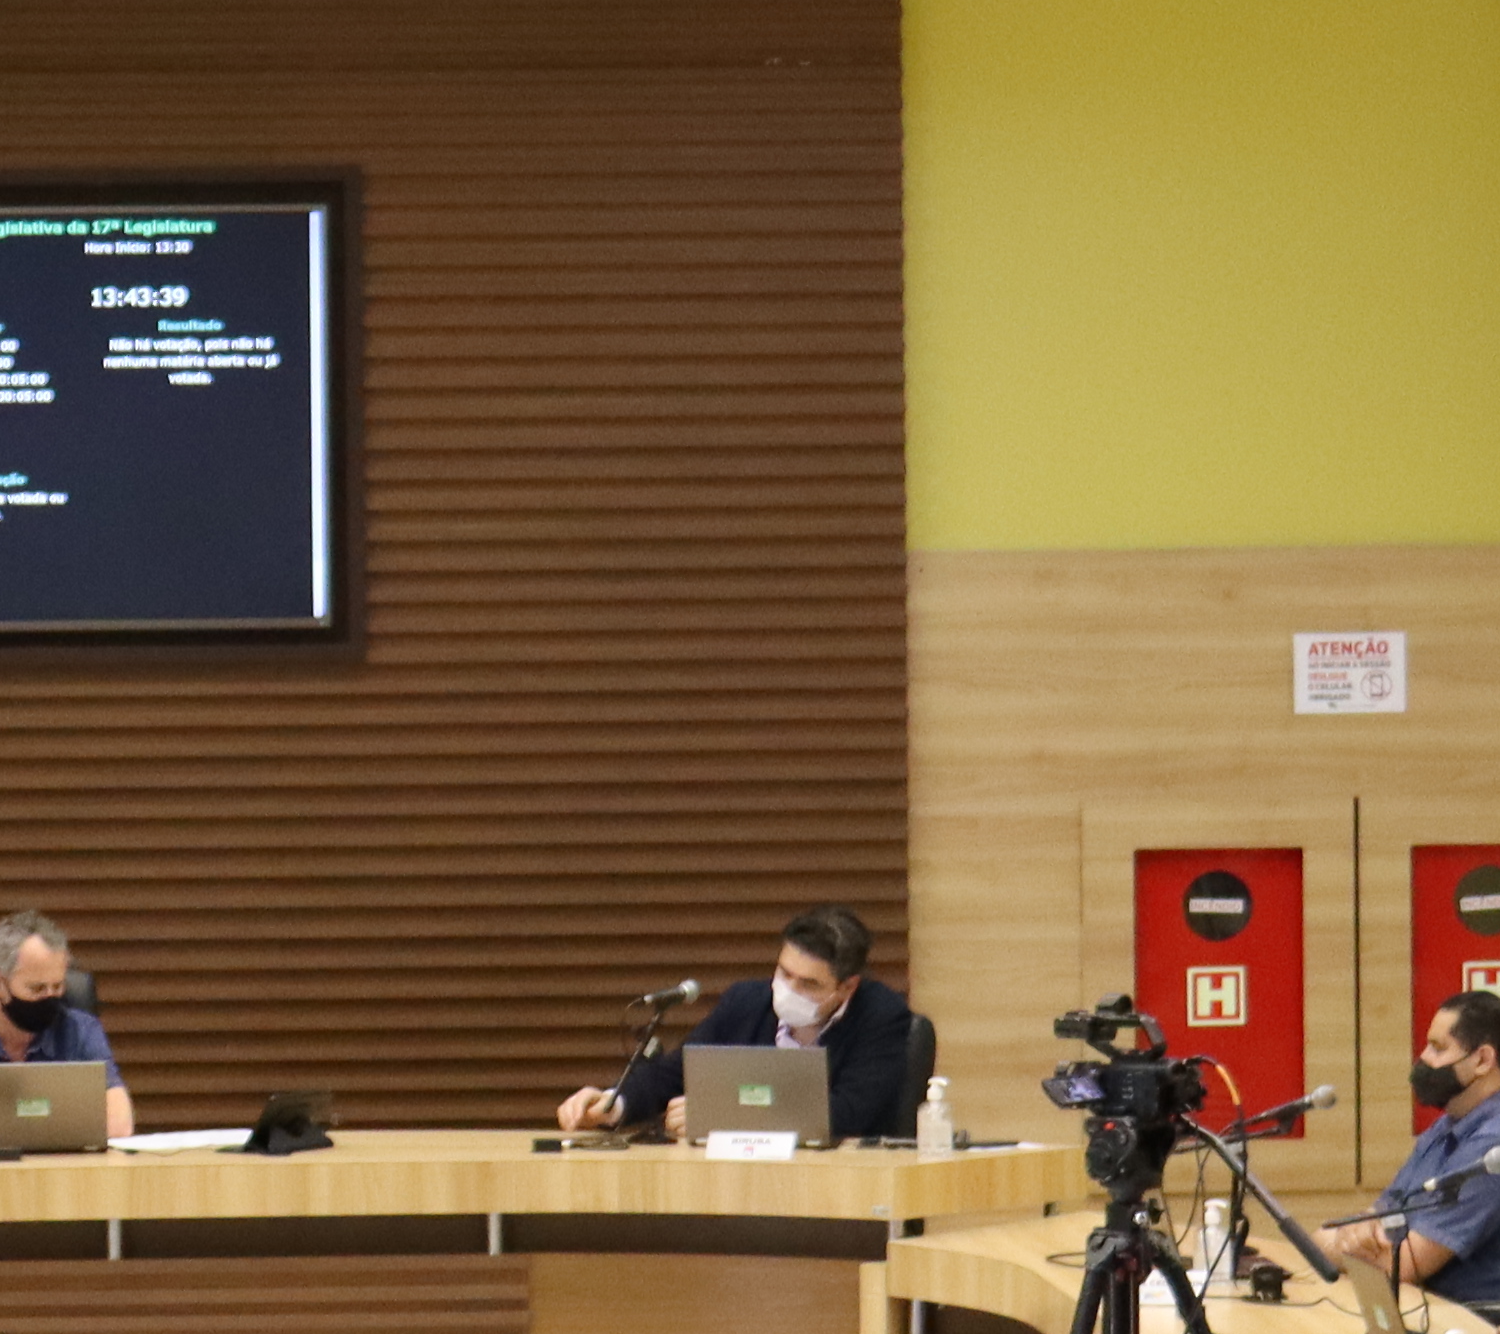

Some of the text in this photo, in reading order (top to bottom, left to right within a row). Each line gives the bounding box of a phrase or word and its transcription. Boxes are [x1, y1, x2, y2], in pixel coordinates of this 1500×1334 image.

[67, 220, 89, 235] da
[91, 219, 122, 234] 17ª
[124, 219, 216, 237] Legislatura
[84, 239, 193, 254] Hora Início: 13:30
[90, 285, 190, 308] 13:43:39
[157, 319, 225, 332] Resultado
[109, 336, 274, 352] Não há votação, pois não há
[103, 353, 281, 369] nenhuma matéria aberta ou já
[168, 371, 215, 385] votada.
[7, 491, 48, 505] votada
[49, 492, 69, 505] ou
[1308, 637, 1389, 658] ATENÇÃO
[1196, 976, 1236, 1016] H
